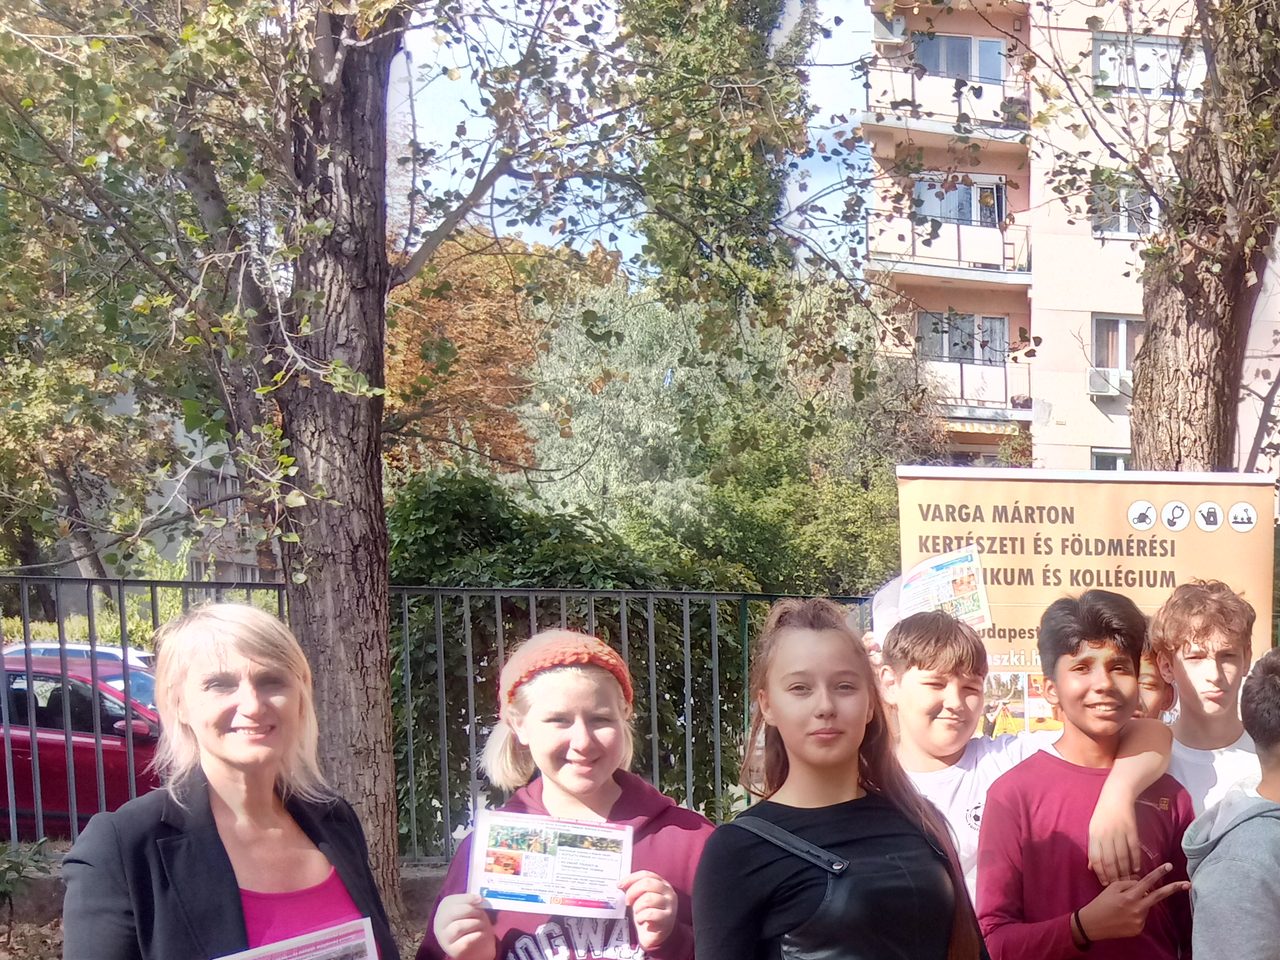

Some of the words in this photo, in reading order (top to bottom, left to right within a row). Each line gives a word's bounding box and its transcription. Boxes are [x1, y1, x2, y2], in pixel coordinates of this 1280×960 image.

[918, 503, 985, 523] VARGA
[992, 500, 1075, 525] MÁRTON
[918, 532, 1025, 555] KERTÉSZETI
[1033, 532, 1054, 556] ÉS
[1061, 534, 1176, 557] FÖLDMÉRÉSI
[1042, 564, 1062, 586] ÉS
[1070, 565, 1177, 588] KOLLÉGIUM
[978, 623, 1040, 643] udapest
